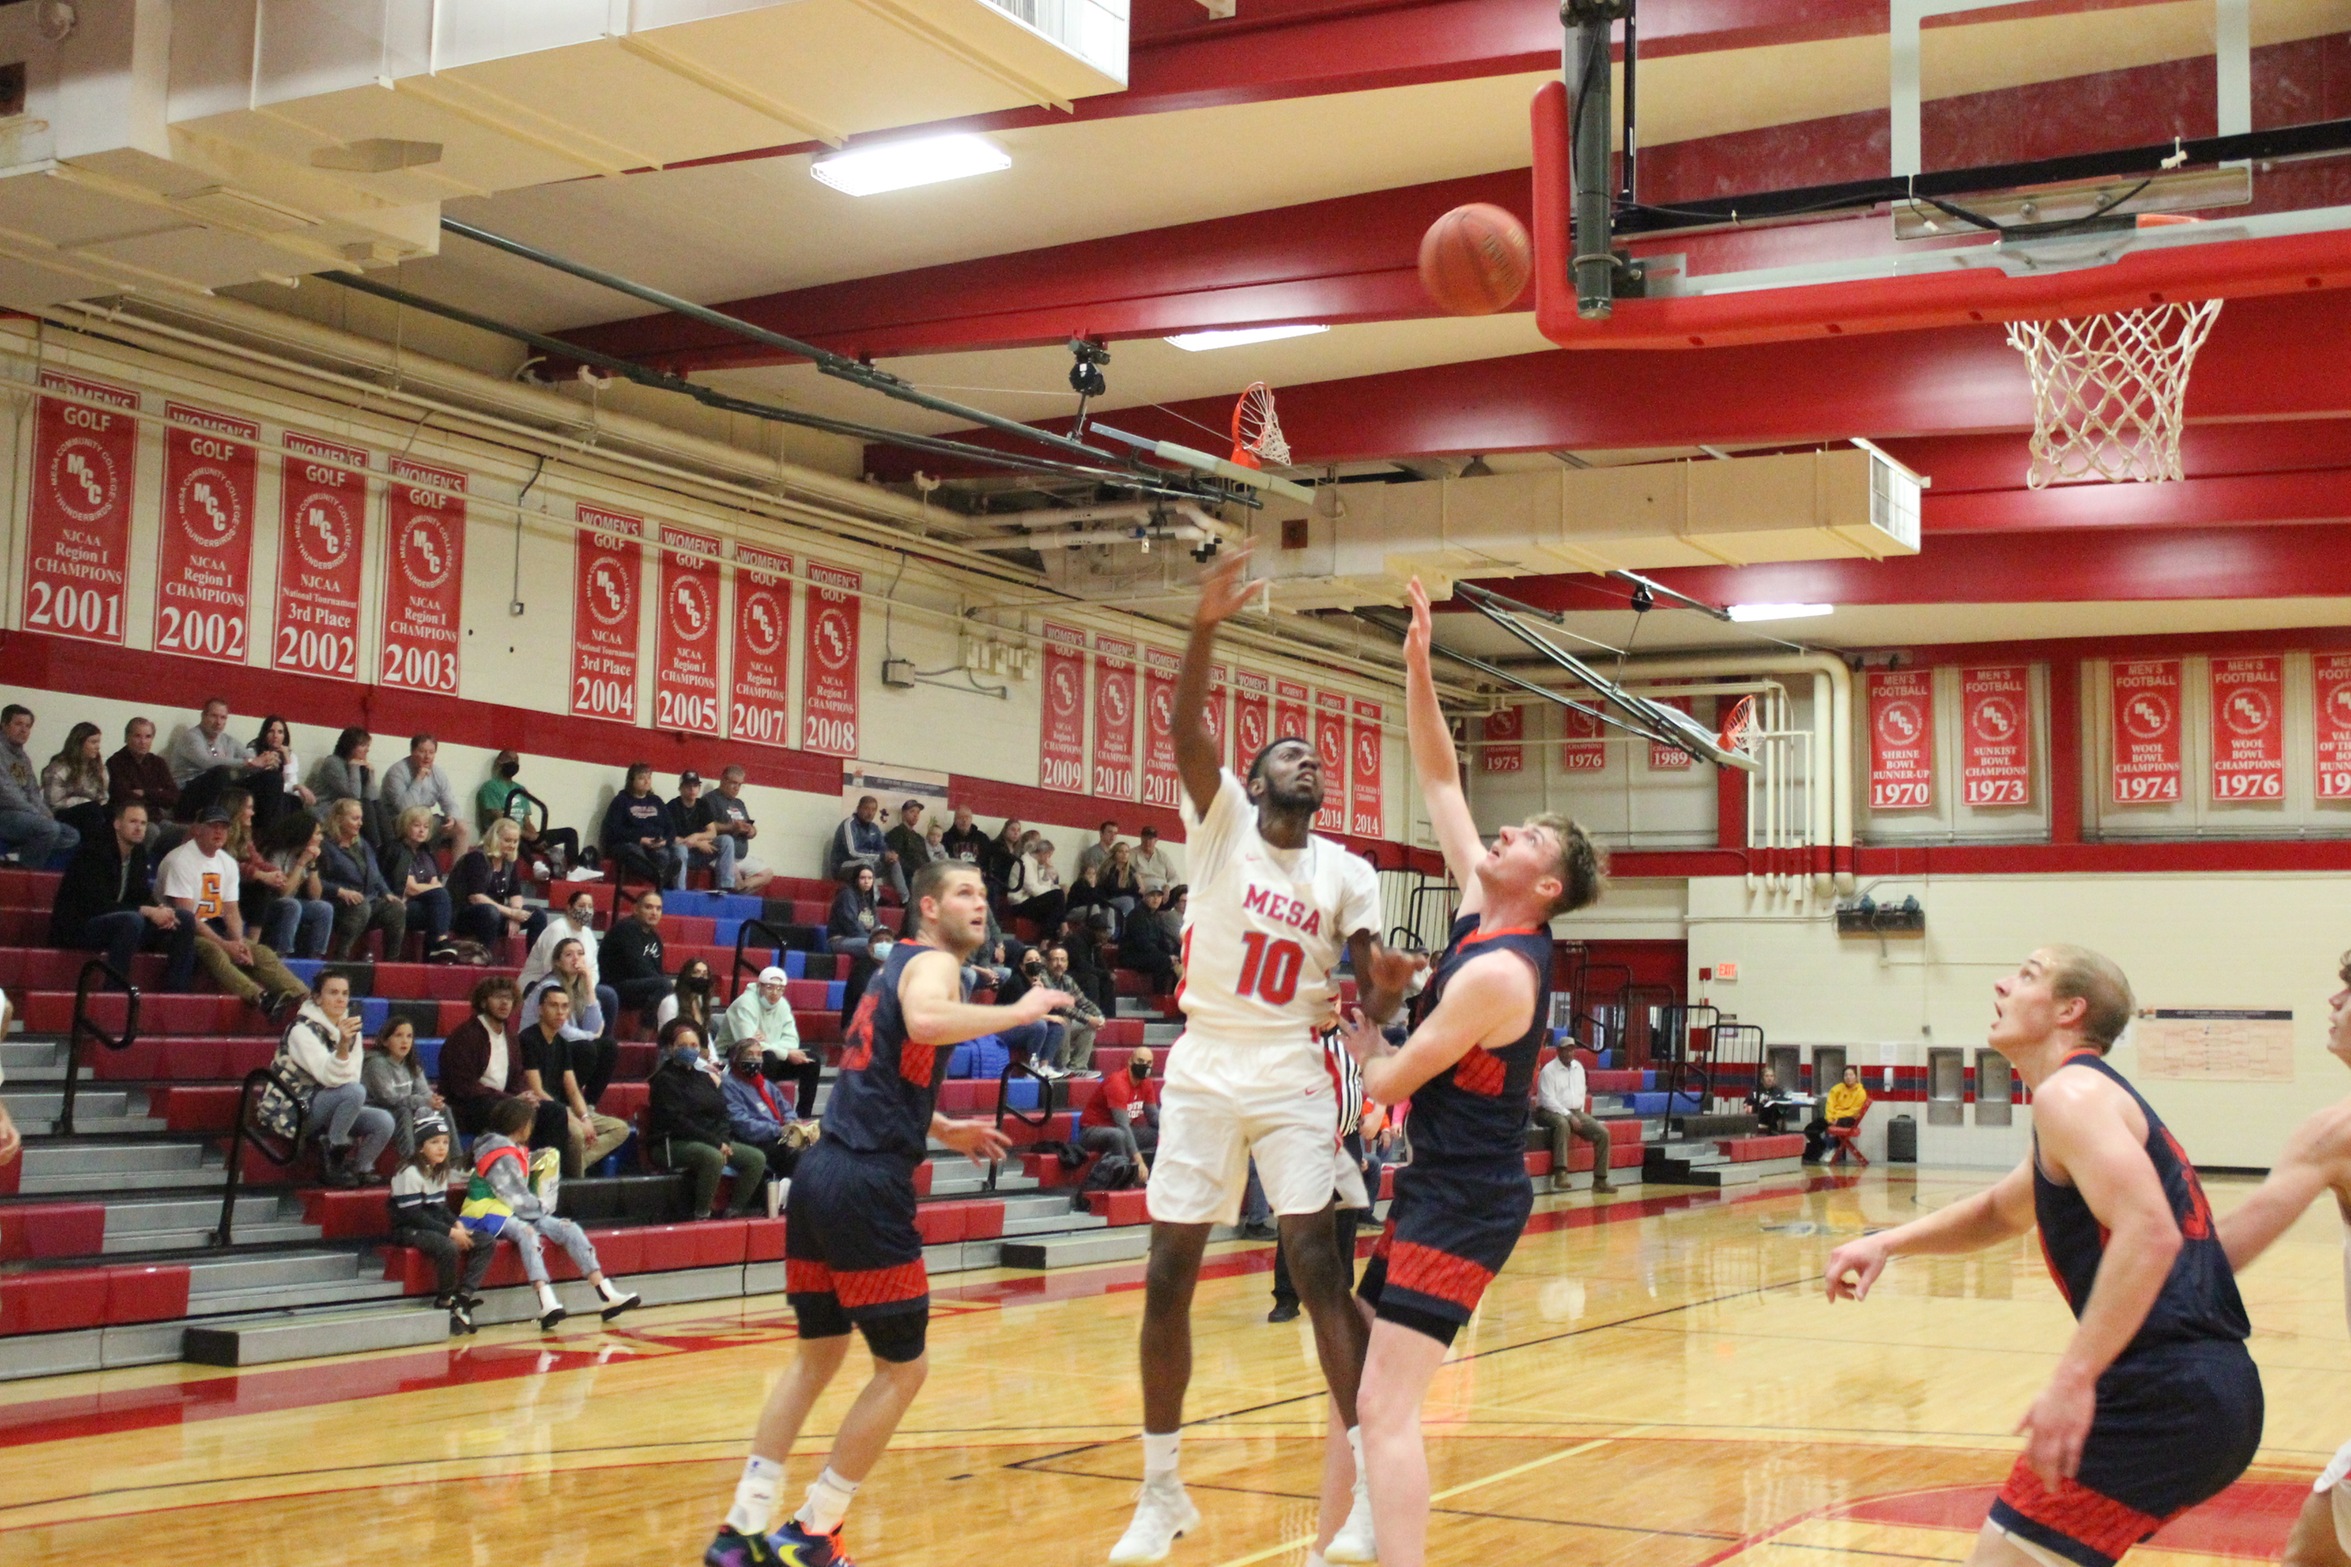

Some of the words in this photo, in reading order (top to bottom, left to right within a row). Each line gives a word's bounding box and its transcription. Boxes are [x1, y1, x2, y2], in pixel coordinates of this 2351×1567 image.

[44, 380, 131, 409] WOMEN'S
[64, 407, 111, 432] GOLF
[173, 411, 252, 440] WOMEN'S
[190, 438, 234, 461] GOLF
[290, 440, 362, 469] WOMEN'S
[51, 457, 60, 485] MESA
[57, 437, 103, 458] COMMUNITY
[102, 451, 117, 498] COLLEGE
[67, 453, 102, 504] MCC
[306, 464, 346, 488] GOLF
[396, 466, 463, 493] WOMEN'S
[54, 492, 114, 521] THUNDERBIRDS
[179, 486, 188, 515] MESA
[184, 467, 227, 486] COMMUNITY
[225, 480, 241, 525] COLLEGE
[194, 483, 226, 531] MCC
[409, 487, 447, 508] GOLF
[294, 513, 303, 539] MESA
[300, 492, 340, 512] COMMUNITY
[338, 505, 352, 548] COLLEGE
[309, 507, 339, 554] MCC
[581, 511, 638, 536] WOMEN'S
[62, 529, 101, 547] NJCAA
[182, 520, 237, 547] THUNDERBIRDS
[405, 514, 441, 533] COMMUNITY
[439, 526, 453, 568] COLLEGE
[593, 533, 625, 552] GOLF
[664, 531, 717, 556] WOMEN'S
[55, 541, 98, 563] Region
[297, 544, 349, 570] THUNDERBIRDS
[413, 529, 441, 574] MCC
[676, 553, 704, 570] GOLF
[741, 549, 790, 573] WOMEN'S
[35, 557, 122, 585] CHAMPIONS
[190, 555, 226, 571] NJCAA
[184, 567, 223, 587] Region
[301, 574, 341, 593] NJCAA
[402, 563, 449, 588] THUNDERBIRDS
[750, 570, 778, 587] GOLF
[811, 568, 857, 590] WOMEN'S
[166, 582, 245, 608] CHAMPIONS
[282, 587, 313, 602] National
[597, 570, 620, 610] MCC
[821, 588, 846, 604] GOLF
[29, 580, 120, 636] 2001
[409, 596, 441, 611] NJCAA
[678, 588, 701, 627] MCC
[289, 603, 312, 623] 3rd
[316, 610, 352, 629] Place
[405, 607, 439, 626] Region
[753, 604, 774, 643] MCC
[160, 606, 244, 657] 2002
[390, 621, 458, 643] CHAMPIONS
[591, 629, 622, 645] NJCAA
[824, 620, 844, 657] MCC
[1047, 626, 1083, 647] WOMEN'S
[278, 626, 355, 674] 2002
[383, 643, 457, 690] 2003
[581, 655, 599, 671] 3rd
[603, 658, 632, 676] Place
[674, 656, 700, 674] Region
[1977, 671, 2011, 681] MEN'S
[2128, 664, 2163, 675] MEN'S
[2227, 660, 2263, 671] MEN'S
[661, 669, 715, 690] CHAMPIONS
[747, 671, 773, 687] Region
[1884, 674, 1916, 686] MEN'S
[1966, 681, 2023, 693] FOOTBALL
[2116, 676, 2176, 688] FOOTBALL
[2215, 671, 2277, 684] FOOTBALL
[575, 675, 633, 715] 2004
[736, 683, 785, 702] CHAMPIONS
[1872, 685, 1928, 698] FOOTBALL
[658, 689, 717, 731] 2005
[808, 696, 854, 714] CHAMPIONS
[2134, 703, 2160, 728] MCC
[2234, 697, 2261, 723] MCC
[733, 703, 785, 742] 2007
[1889, 711, 1913, 736] MCC
[1983, 706, 2008, 732] MCC
[806, 715, 855, 752] 2008
[2231, 739, 2264, 749] WOOL
[2332, 731, 2351, 741] VAL
[1654, 752, 1689, 766] 1989
[1882, 749, 1920, 760] SHRINE
[1973, 746, 2017, 756] SUNKIST
[2131, 743, 2164, 753] WOOL
[2132, 753, 2164, 763] BOWL
[2232, 749, 2264, 760] BOWL
[2336, 752, 2351, 761] BO
[1487, 756, 1520, 770] 1975
[1568, 753, 1602, 768] 1976
[1886, 759, 1915, 770] BOWL
[1965, 766, 2026, 777] CHAMPIONS
[1980, 756, 2011, 766] BOWL
[2115, 762, 2179, 773] CHAMPIONS
[2215, 759, 2281, 771] CHAMPIONS
[2320, 762, 2351, 771] RUNN
[1043, 756, 1082, 789] 2009
[1095, 765, 1132, 797] 2010
[1873, 770, 1930, 780] RUNNER-UP
[2321, 772, 2351, 795] 19
[1145, 774, 1179, 805] 2011
[1874, 783, 1929, 805] 1970
[1968, 780, 2024, 801] 1973
[2118, 776, 2178, 799] 1974
[2218, 773, 2279, 797] 1976
[1320, 807, 1342, 829] 2014
[1355, 812, 1379, 835] 2014
[1242, 883, 1320, 937] MESA
[1235, 930, 1306, 1007] 10
[1719, 963, 1737, 977] EXIT
